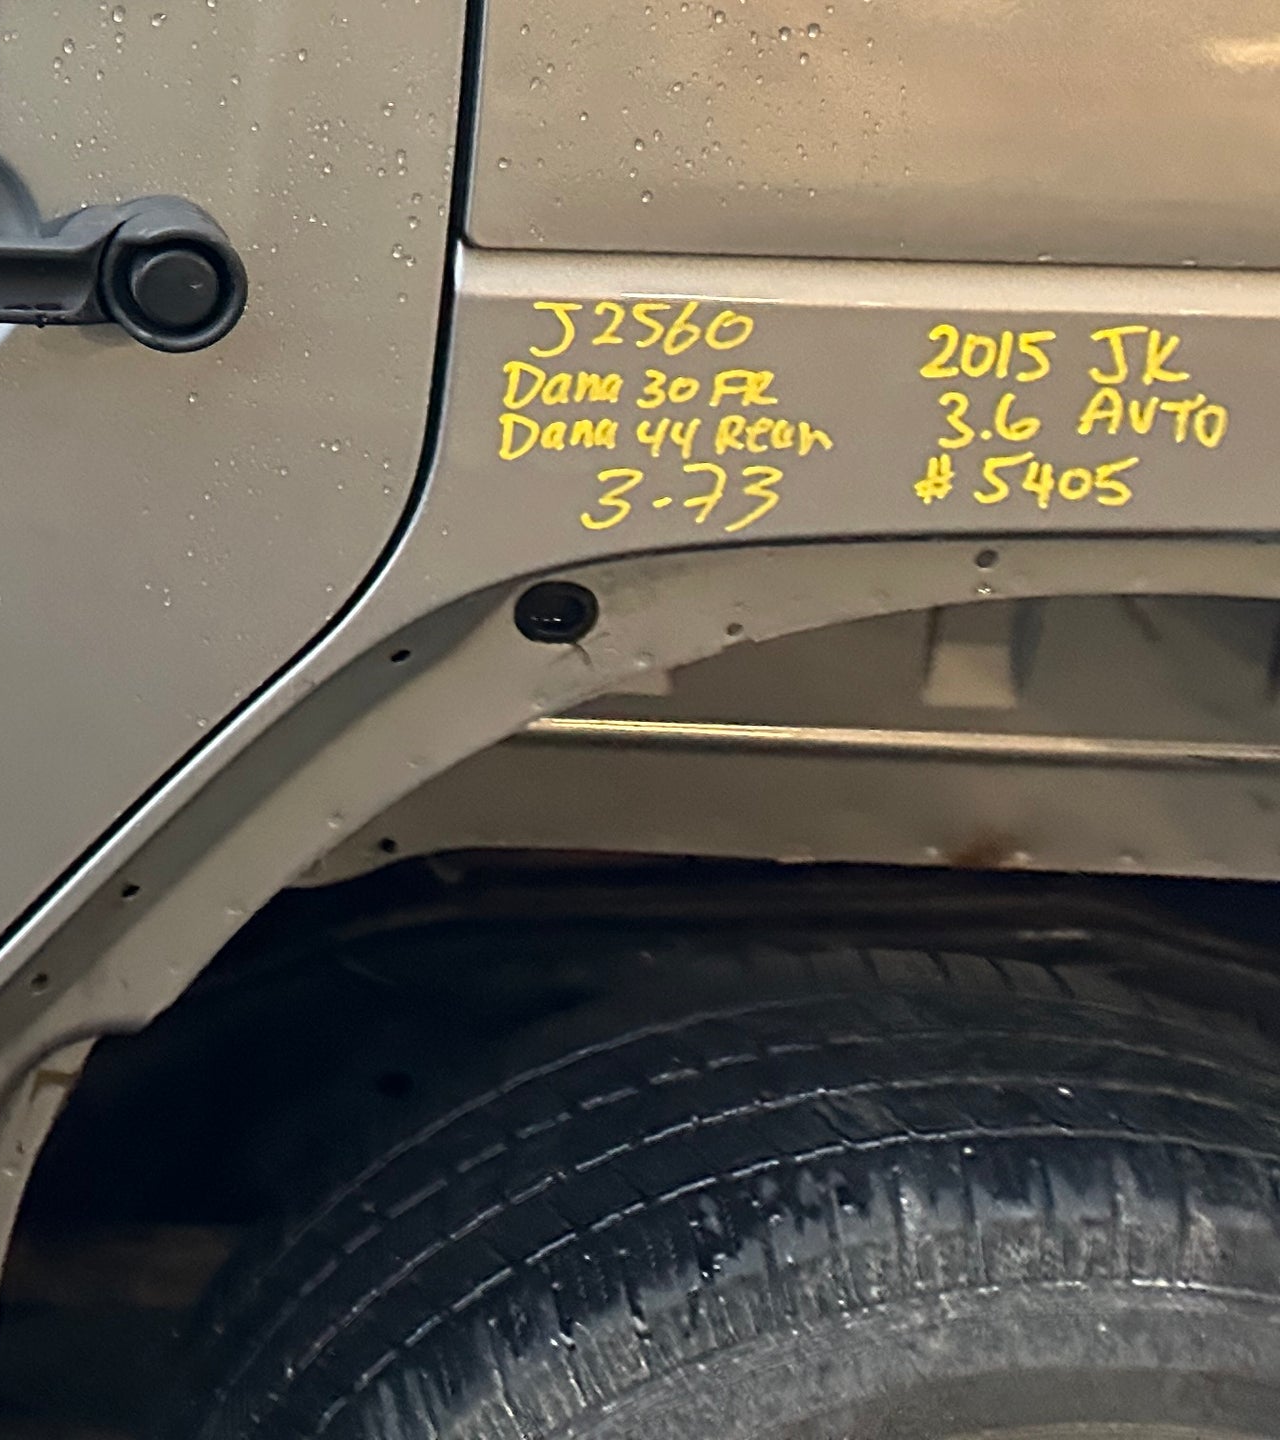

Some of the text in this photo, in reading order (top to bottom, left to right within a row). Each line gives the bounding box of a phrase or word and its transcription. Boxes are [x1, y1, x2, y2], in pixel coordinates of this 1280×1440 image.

[528, 299, 756, 359] J2560
[919, 322, 1192, 386] 2015 JK
[502, 360, 779, 410] Dana 30 FR
[498, 412, 834, 461] Dana 44 Rear
[937, 386, 1230, 451] 3.6 AUTO
